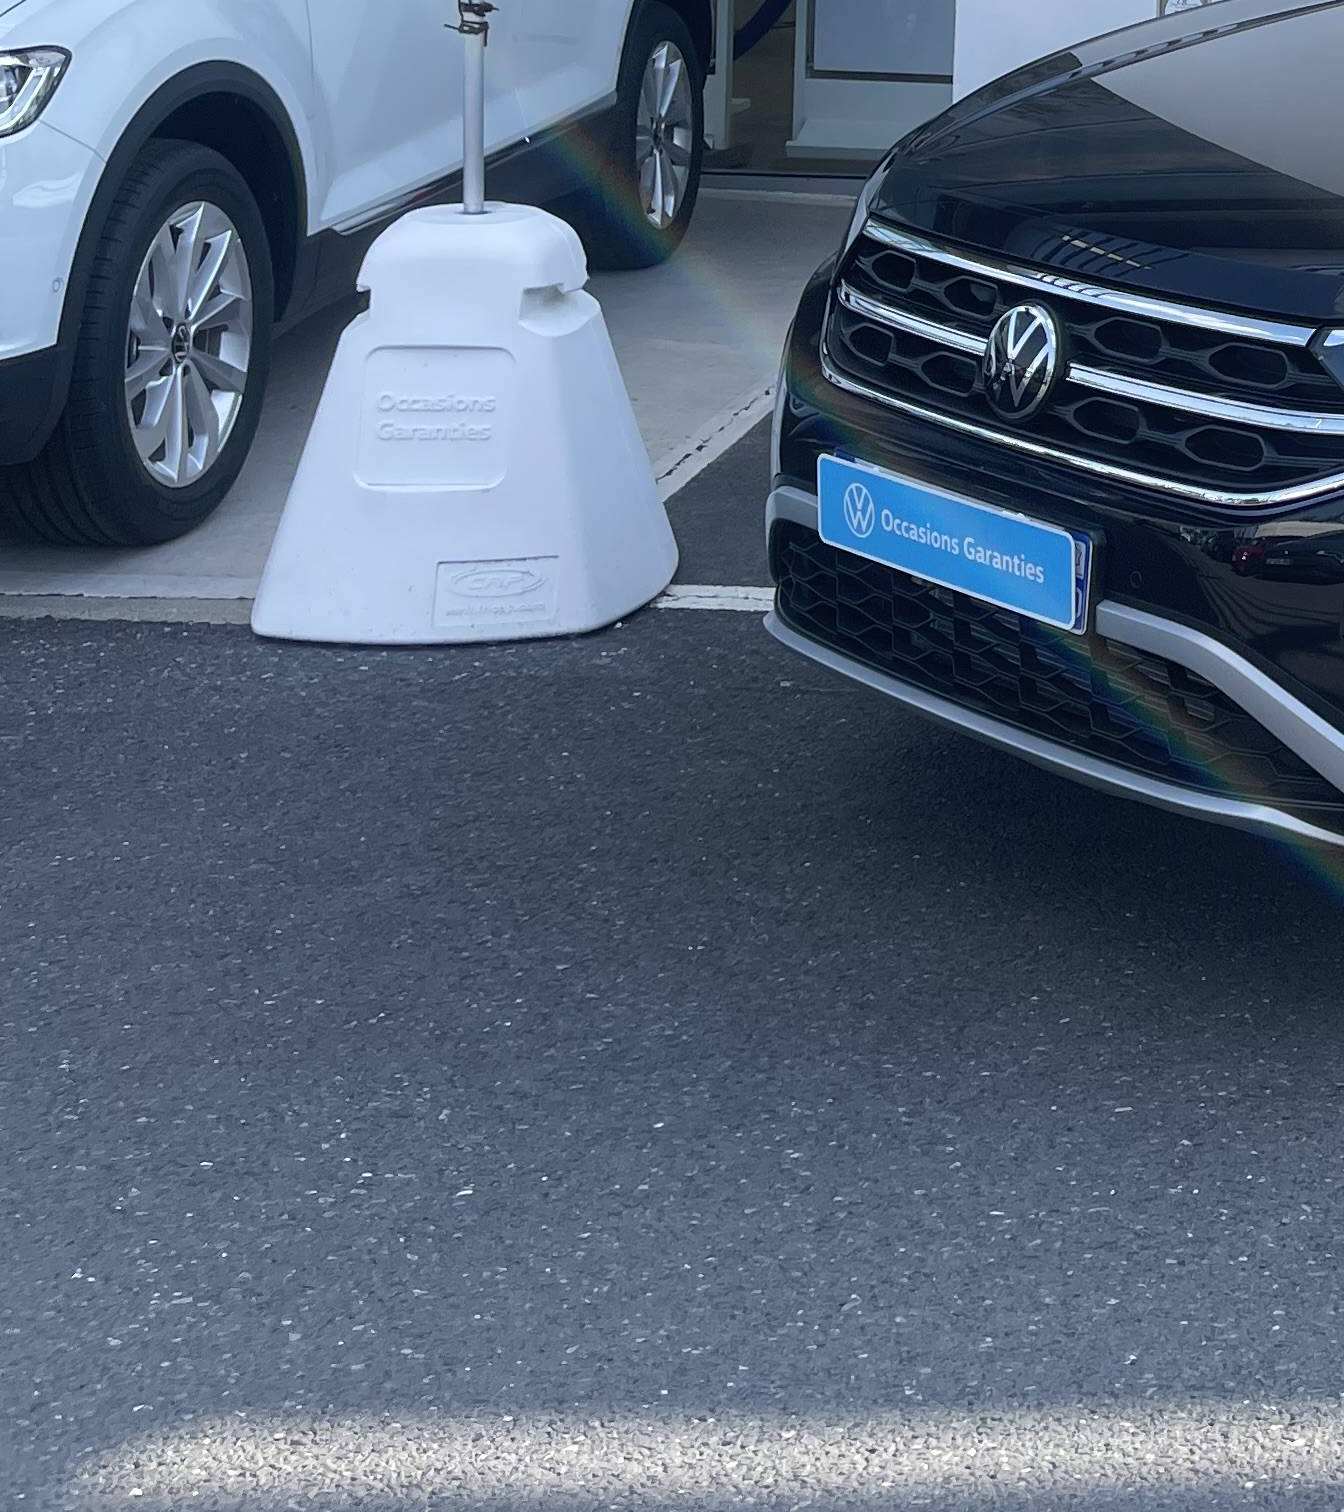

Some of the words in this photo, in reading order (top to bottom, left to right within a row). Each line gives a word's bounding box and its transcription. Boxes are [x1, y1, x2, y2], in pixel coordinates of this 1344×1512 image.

[377, 392, 496, 414] Occasions
[376, 420, 492, 442] Garanties
[881, 508, 960, 556] Occasions
[963, 536, 1045, 584] Garanties
